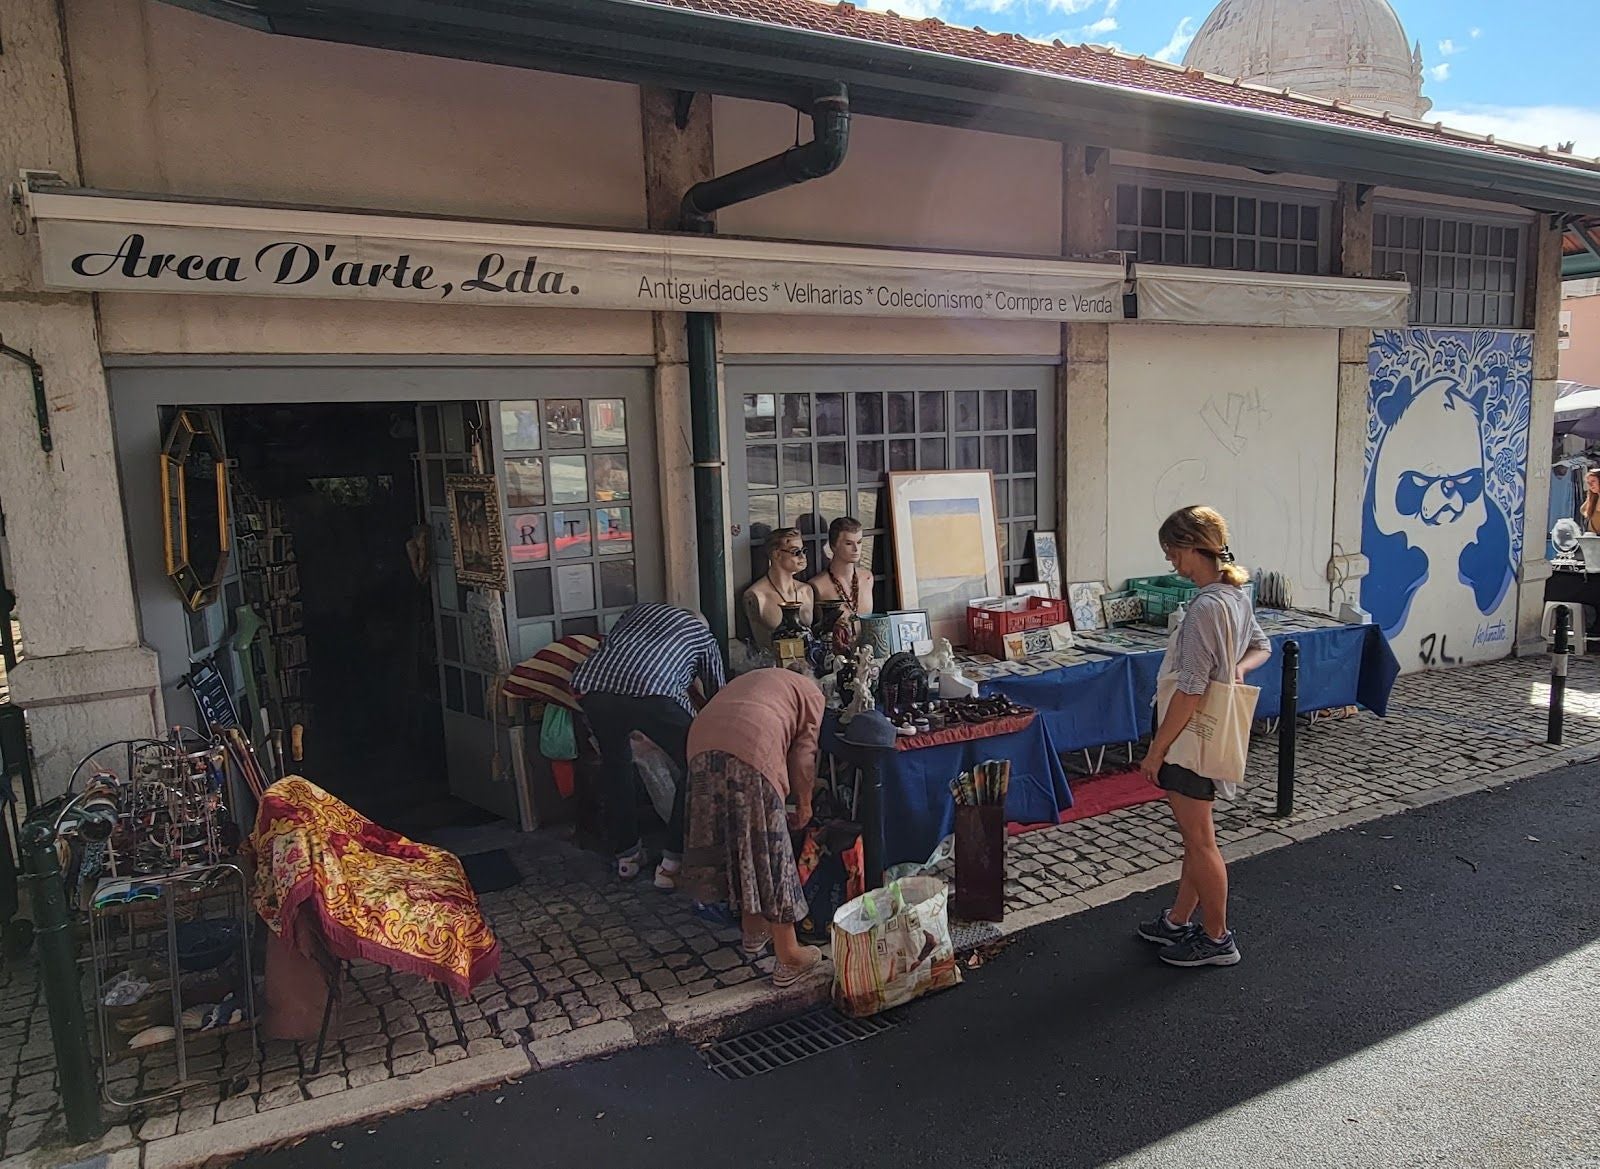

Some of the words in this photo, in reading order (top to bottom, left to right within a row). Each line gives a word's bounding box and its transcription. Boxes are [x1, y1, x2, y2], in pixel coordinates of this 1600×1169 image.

[71, 233, 248, 283] Arca
[255, 241, 453, 300] D'arte,
[460, 252, 581, 296] Lda.
[637, 275, 769, 304] Antiguidades
[784, 281, 864, 306] Velharias
[876, 286, 984, 310] Colecionismo
[995, 291, 1054, 315] Compra
[1058, 297, 1068, 312] e
[1071, 294, 1113, 314] Venda
